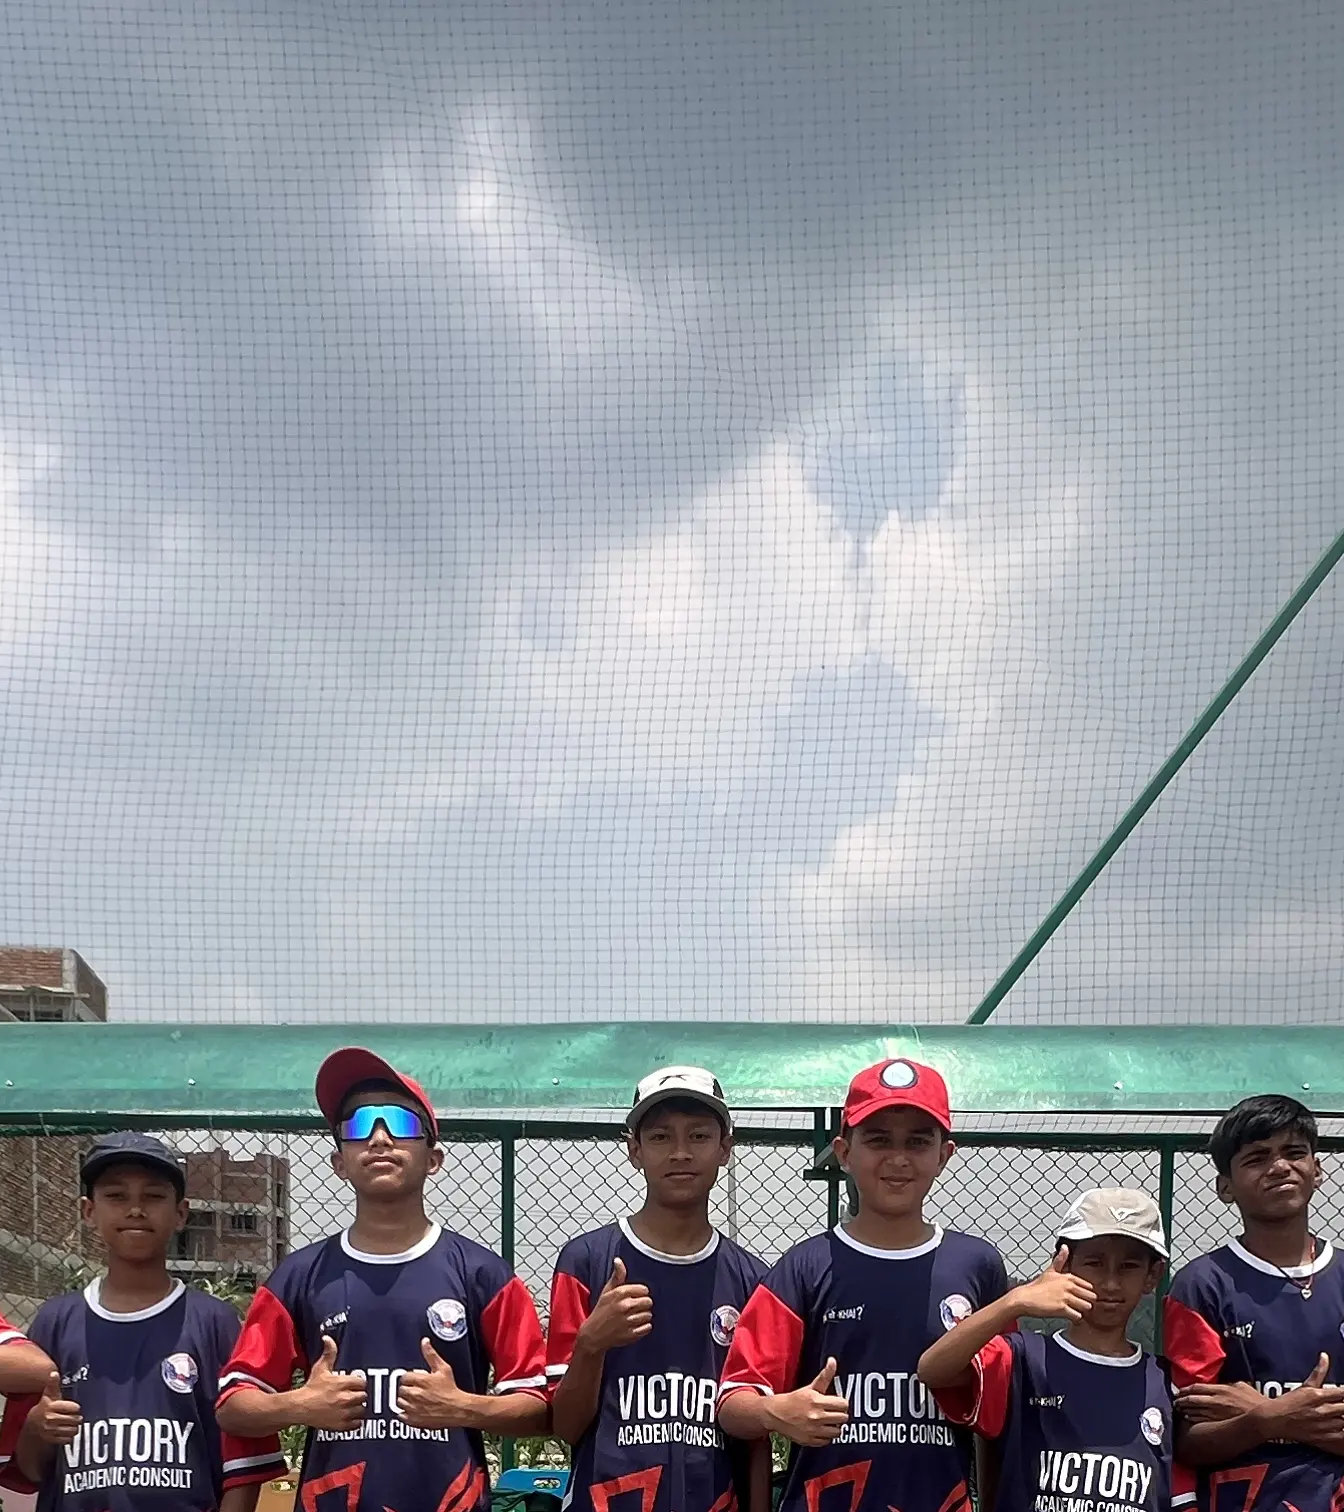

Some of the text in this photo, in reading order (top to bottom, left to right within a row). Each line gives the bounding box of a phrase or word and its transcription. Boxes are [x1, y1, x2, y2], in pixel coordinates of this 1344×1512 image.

[618, 1372, 719, 1423] VICTOR
[834, 1372, 946, 1420] VICTO
[64, 1418, 194, 1468] VICTORY
[64, 1466, 193, 1494] ACADEMIC CONSULT
[1039, 1450, 1152, 1505] VICTORY
